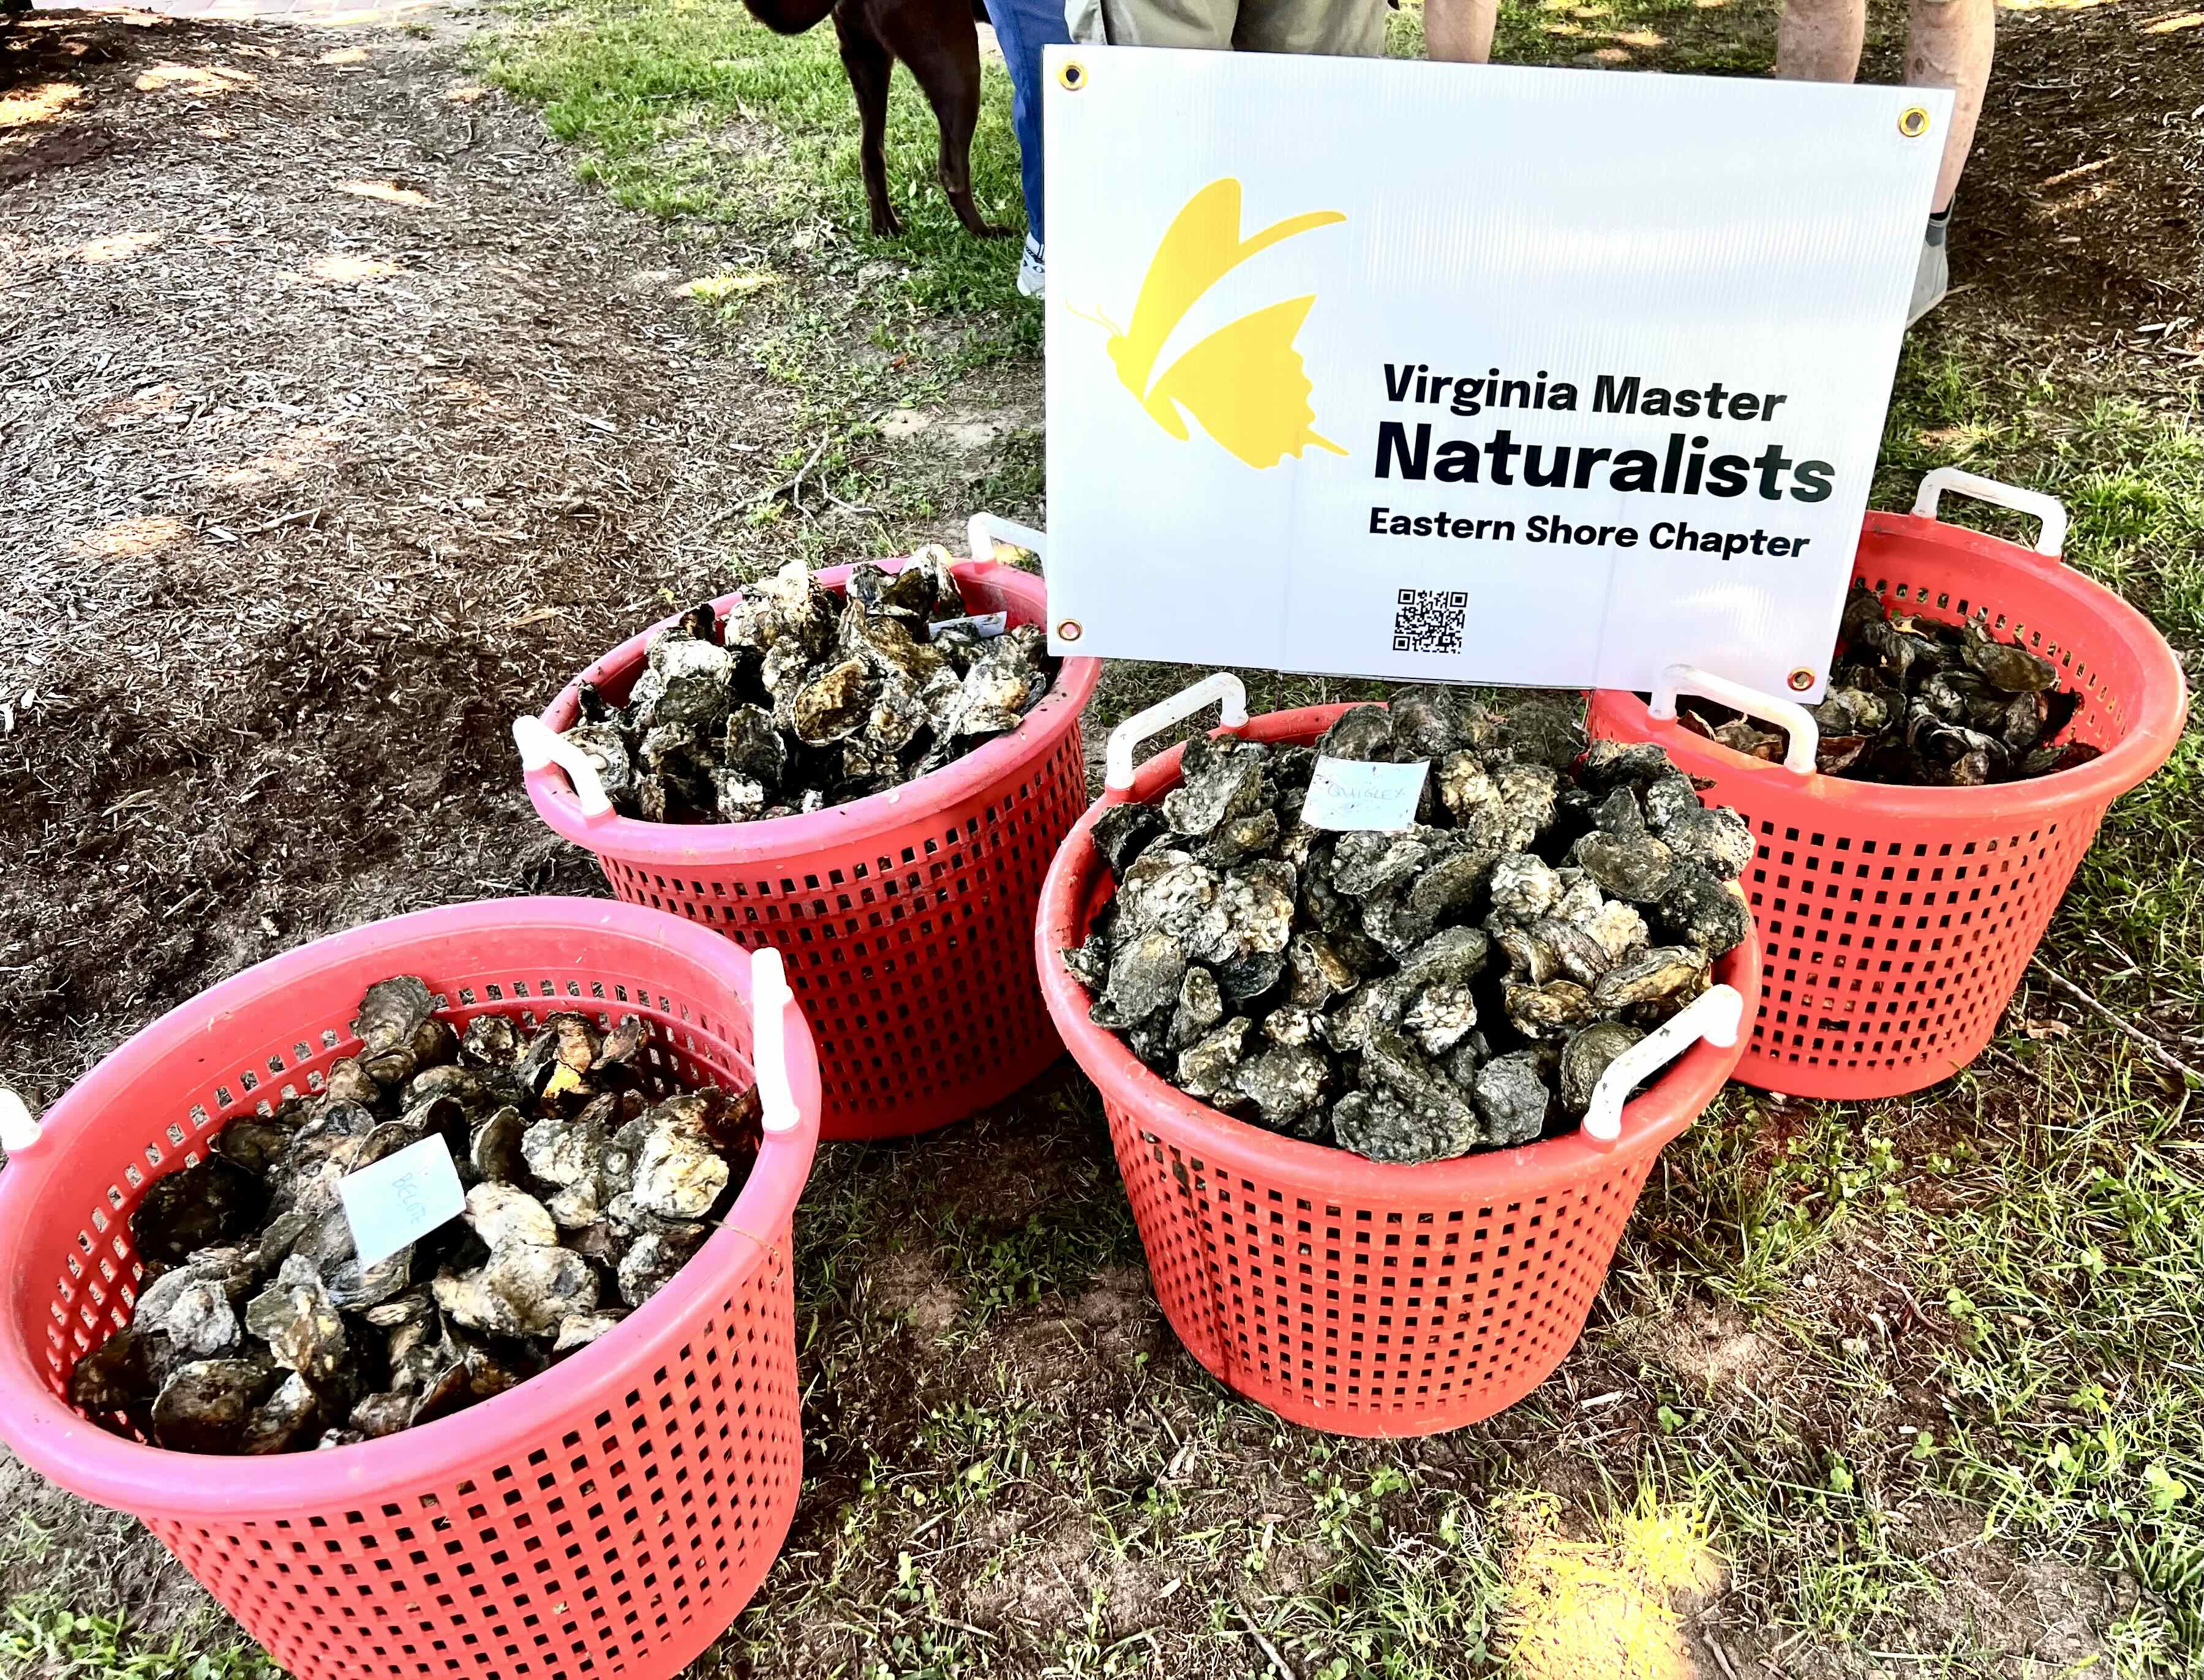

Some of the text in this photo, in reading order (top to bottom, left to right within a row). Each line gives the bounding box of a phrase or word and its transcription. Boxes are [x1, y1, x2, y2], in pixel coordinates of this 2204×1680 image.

[1383, 364, 1788, 422] Virginia Master
[1374, 421, 1835, 503] Naturalists
[1369, 507, 1811, 561] Eastern Shore Chapter
[1327, 783, 1405, 800] QUIGLEY
